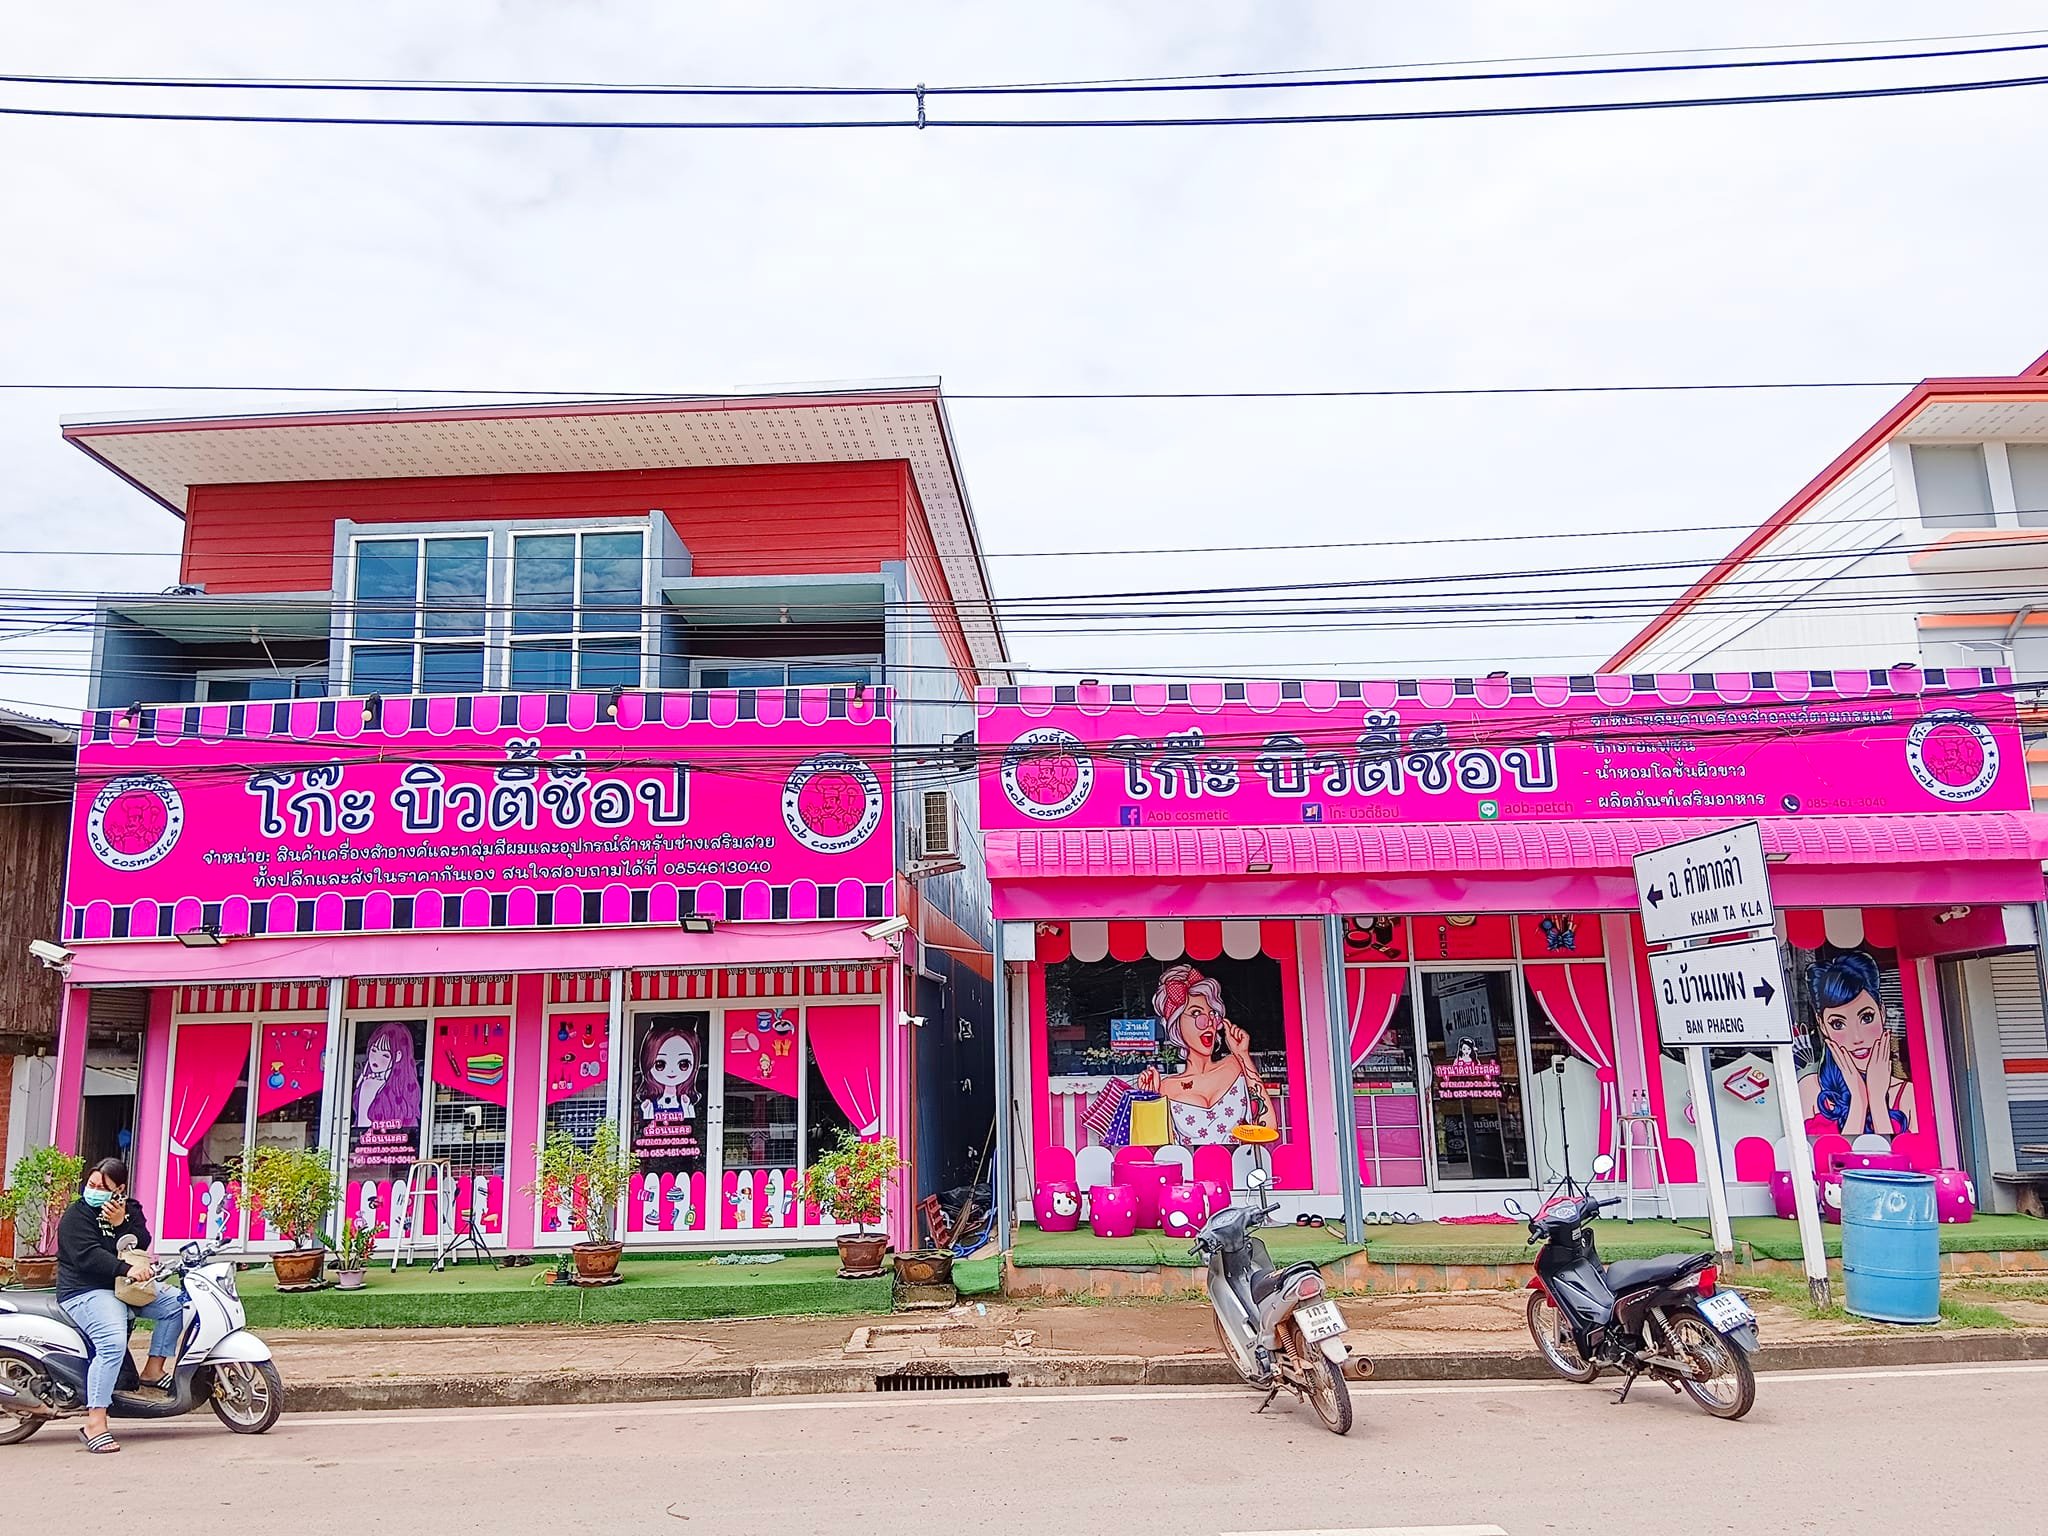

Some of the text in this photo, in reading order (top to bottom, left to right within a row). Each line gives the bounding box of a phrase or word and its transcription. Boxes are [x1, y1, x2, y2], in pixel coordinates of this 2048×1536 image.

[245, 737, 691, 837] โก๊ะ บิวตี้ช็อป
[1598, 789, 1766, 808] ผลิตภัณฑ์เสริมอาหาร
[1912, 763, 1997, 799] aob cosmetics
[1006, 781, 1090, 817] aob cosmetics
[1147, 809, 1171, 821] Aob
[1175, 809, 1229, 821] cosmetic
[1504, 801, 1574, 816] aob-petch
[91, 829, 178, 867] aob cosmetics
[787, 811, 878, 850] aob cosmetics
[203, 847, 271, 866] จำหน่าย:
[253, 854, 771, 888] ทั้งปลีกและส่งในราคากันเอง สนใจสอบถามได้ที่ 0854613040
[1684, 845, 1743, 896] คำตากล้า
[1691, 901, 1763, 926] KHAM TA KLA
[1679, 962, 1746, 1003] บ้านแพง
[1686, 1018, 1744, 1034] BAN PHAENG
